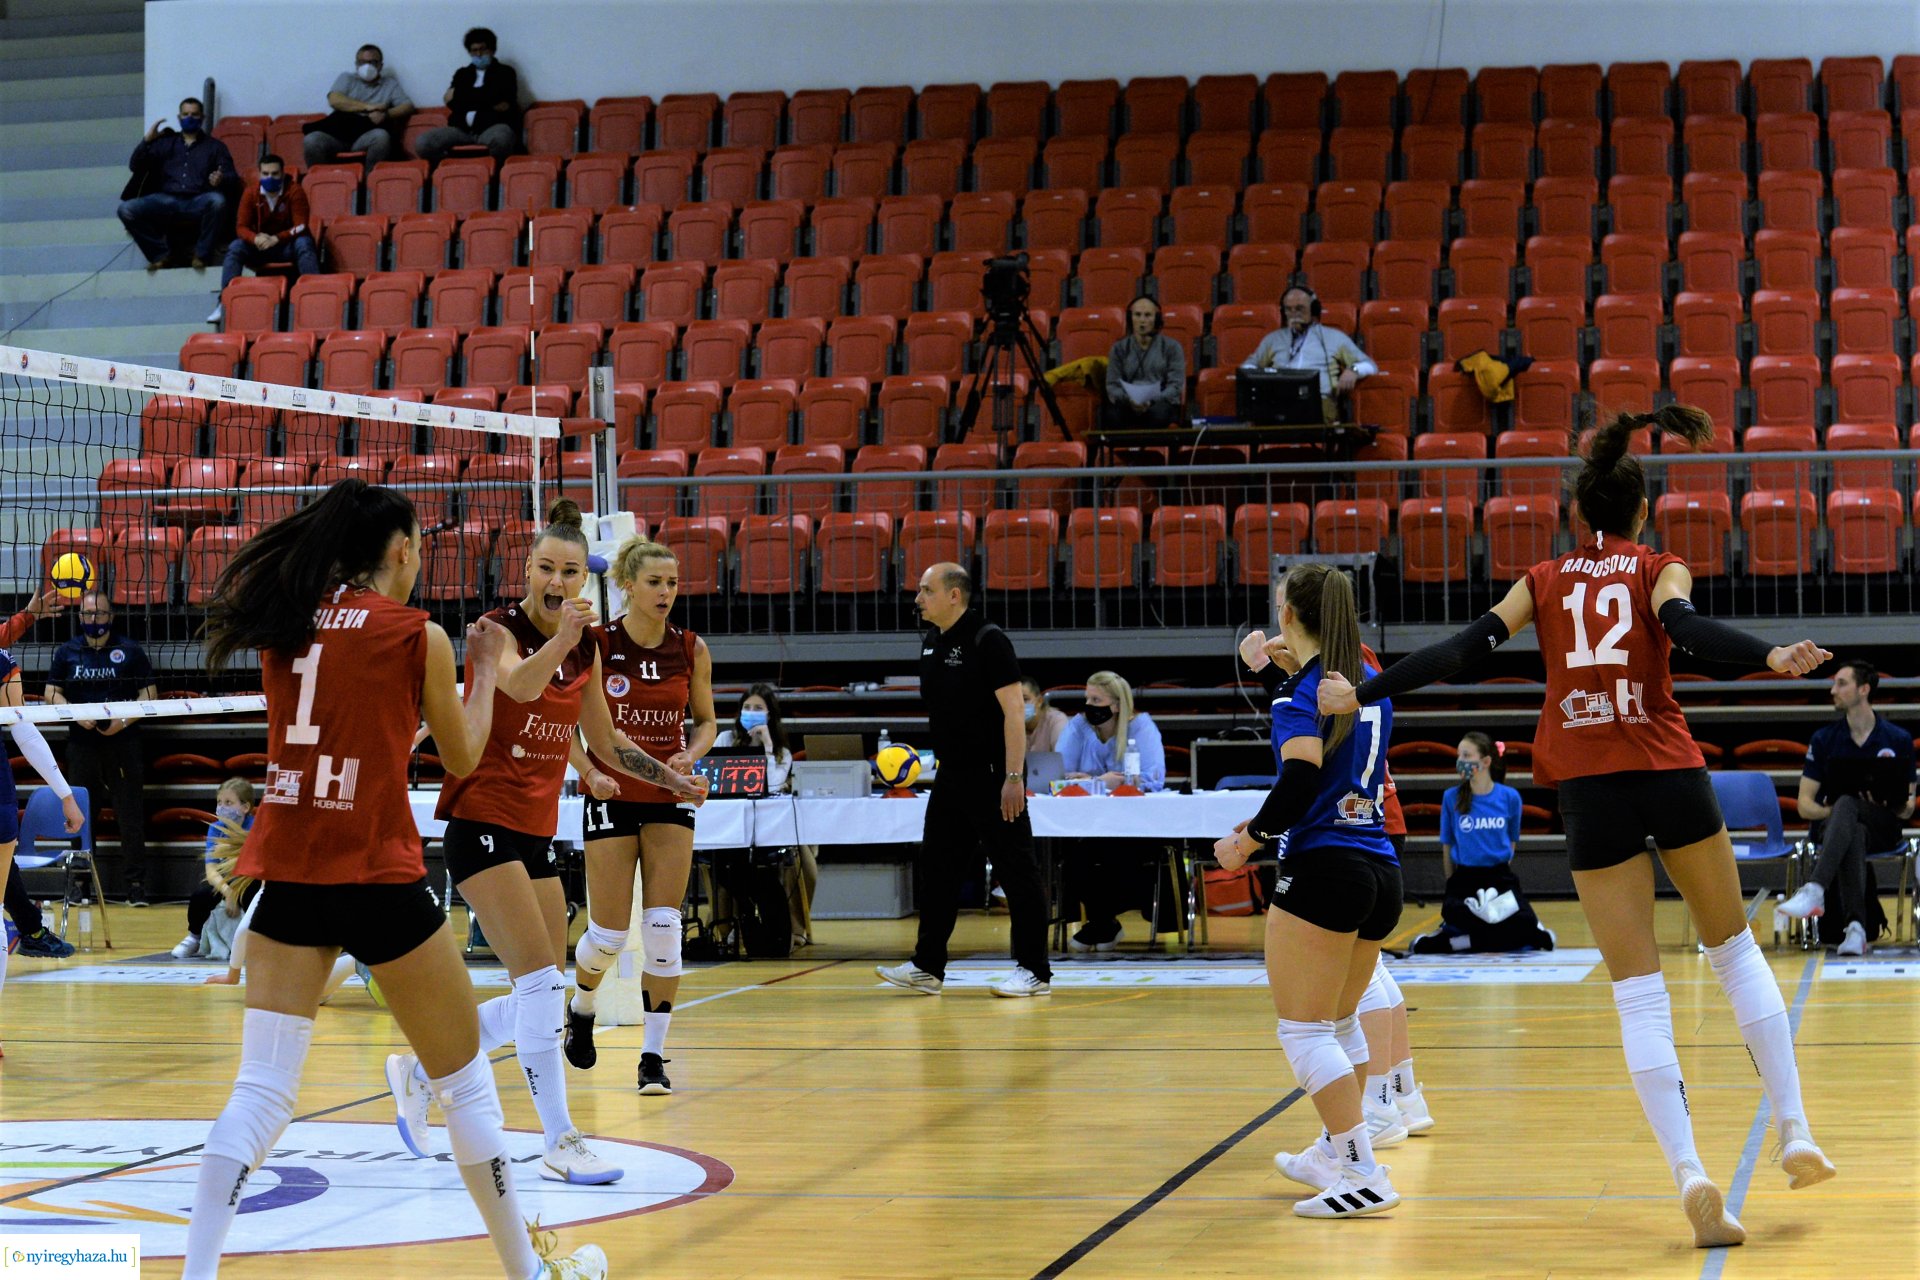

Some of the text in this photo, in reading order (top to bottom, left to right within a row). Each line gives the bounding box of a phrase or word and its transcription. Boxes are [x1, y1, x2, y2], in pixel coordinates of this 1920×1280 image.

[1560, 554, 1638, 578] RADOSOVA
[312, 608, 370, 629] SILEVA
[1562, 582, 1633, 669] 12
[74, 665, 116, 679] FATUM
[640, 660, 661, 680] 11
[285, 643, 324, 745] 1
[616, 702, 680, 723] FATUM
[1359, 705, 1382, 789] 7
[1355, 799, 1375, 809] FIT
[586, 802, 614, 832] 11
[1474, 816, 1506, 830] JAKO
[480, 834, 494, 853] 9
